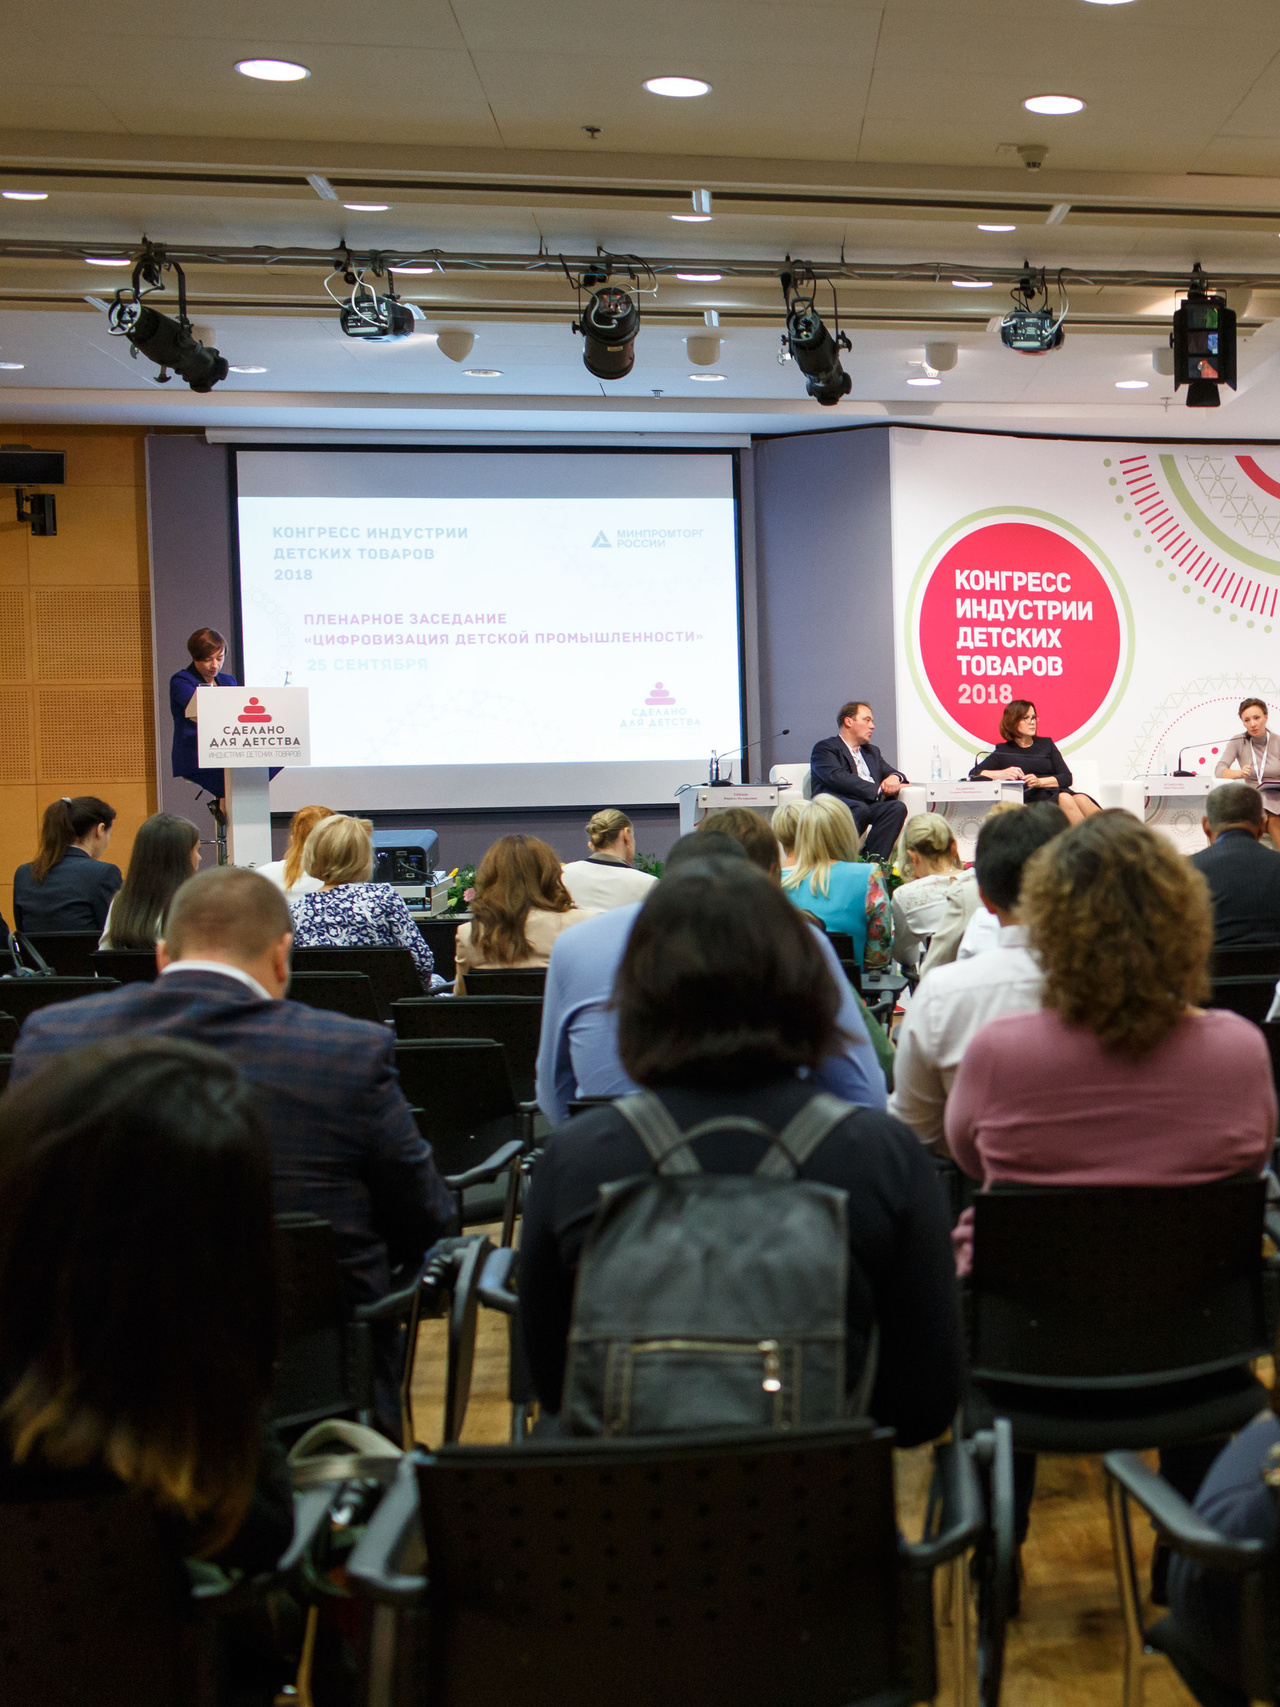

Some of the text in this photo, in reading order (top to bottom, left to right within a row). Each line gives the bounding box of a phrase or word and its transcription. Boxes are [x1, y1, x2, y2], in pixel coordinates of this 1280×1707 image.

[272, 526, 468, 540] КОНГРЕСС ИНДУСТРИИ
[616, 528, 705, 538] МИНПРОМТОРГ
[616, 539, 666, 549] РОССИИ
[272, 547, 435, 560] ДЕТСКИХ ТОВАРОВ
[273, 568, 313, 581] 2018
[954, 569, 1072, 593] КОНГРЕСС
[956, 597, 1093, 622] ИНДУСТРИИ
[303, 613, 507, 626] ПЛЕНАРНОЕ ЗАСЕДАНИЕ
[304, 630, 703, 646] «ЦИФРОВИЗАЦИЯ ДЕТСКОЙ ПРОМЫШЛЕННОСТИ»
[956, 626, 1062, 650] ДЕТСКИХ
[306, 657, 429, 672] 25 СЕНТЯБРЯ
[956, 654, 1063, 676] ТОВАРОВ
[957, 683, 1013, 704] 2018
[631, 707, 687, 717] СДЕЛАНО
[619, 717, 702, 728] ДЛЯ ДЕТСТВА
[223, 725, 285, 736] СДЕЛАНО
[209, 737, 301, 748] ДЛЯ ДЕТСТВА
